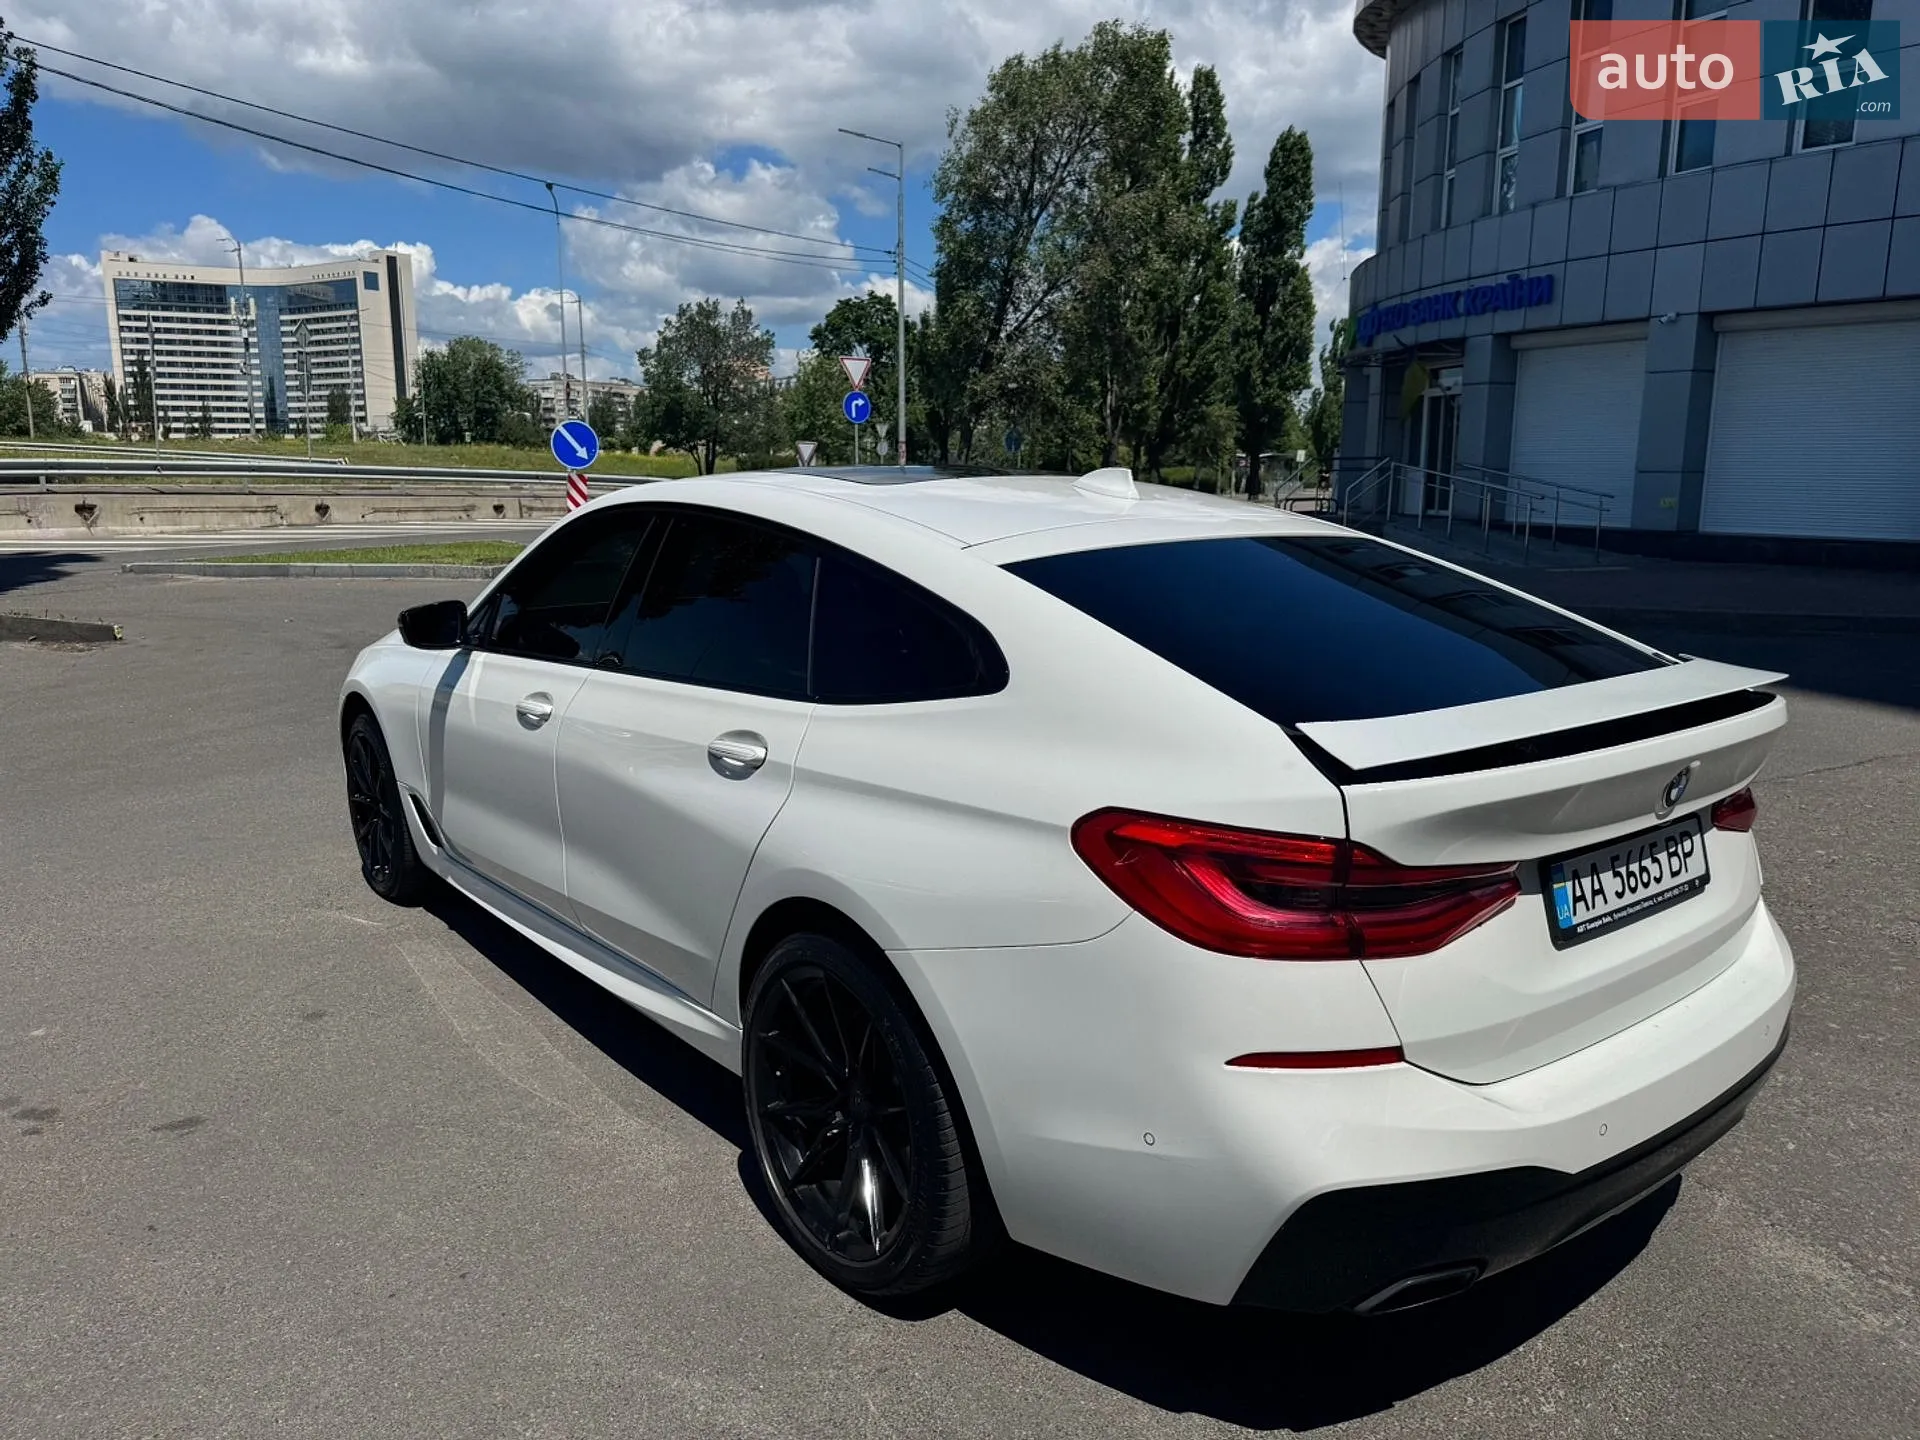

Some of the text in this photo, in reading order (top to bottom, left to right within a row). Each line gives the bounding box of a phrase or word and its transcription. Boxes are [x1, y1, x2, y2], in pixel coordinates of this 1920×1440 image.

[1572, 861, 1608, 916] AA
[1610, 841, 1664, 899] 5665
[1665, 830, 1695, 878] BP
[1557, 906, 1571, 920] UA
